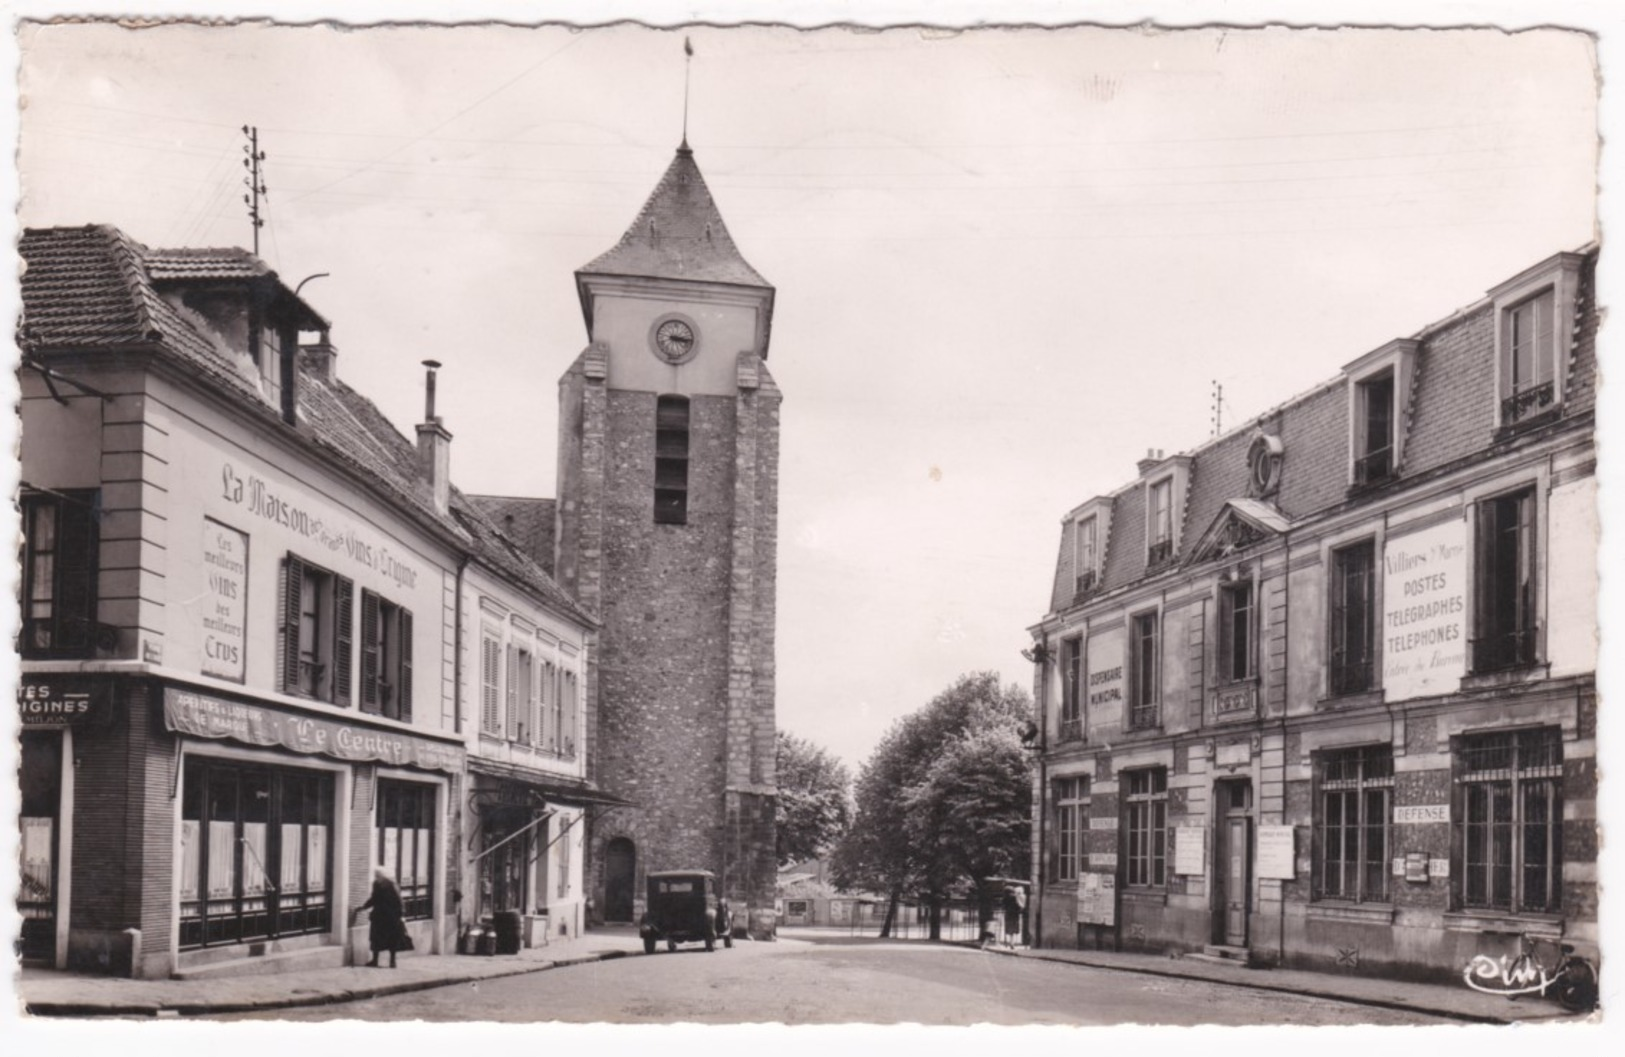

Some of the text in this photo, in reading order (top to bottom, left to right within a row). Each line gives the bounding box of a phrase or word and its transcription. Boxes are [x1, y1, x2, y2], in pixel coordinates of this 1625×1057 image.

[222, 462, 243, 504] La
[247, 476, 310, 537] Maison
[203, 550, 244, 576] meilleurs
[1385, 551, 1427, 576] Villiers
[1404, 572, 1447, 597] POSTES
[1386, 595, 1464, 628] TELEGRAPHES
[202, 617, 242, 638] meilleurs
[1387, 623, 1460, 654] TELEPHONES
[1091, 688, 1122, 705] MUNICIPAL
[287, 717, 328, 746] Le
[336, 726, 402, 755] Centre
[1397, 807, 1446, 821] DEFENSE
